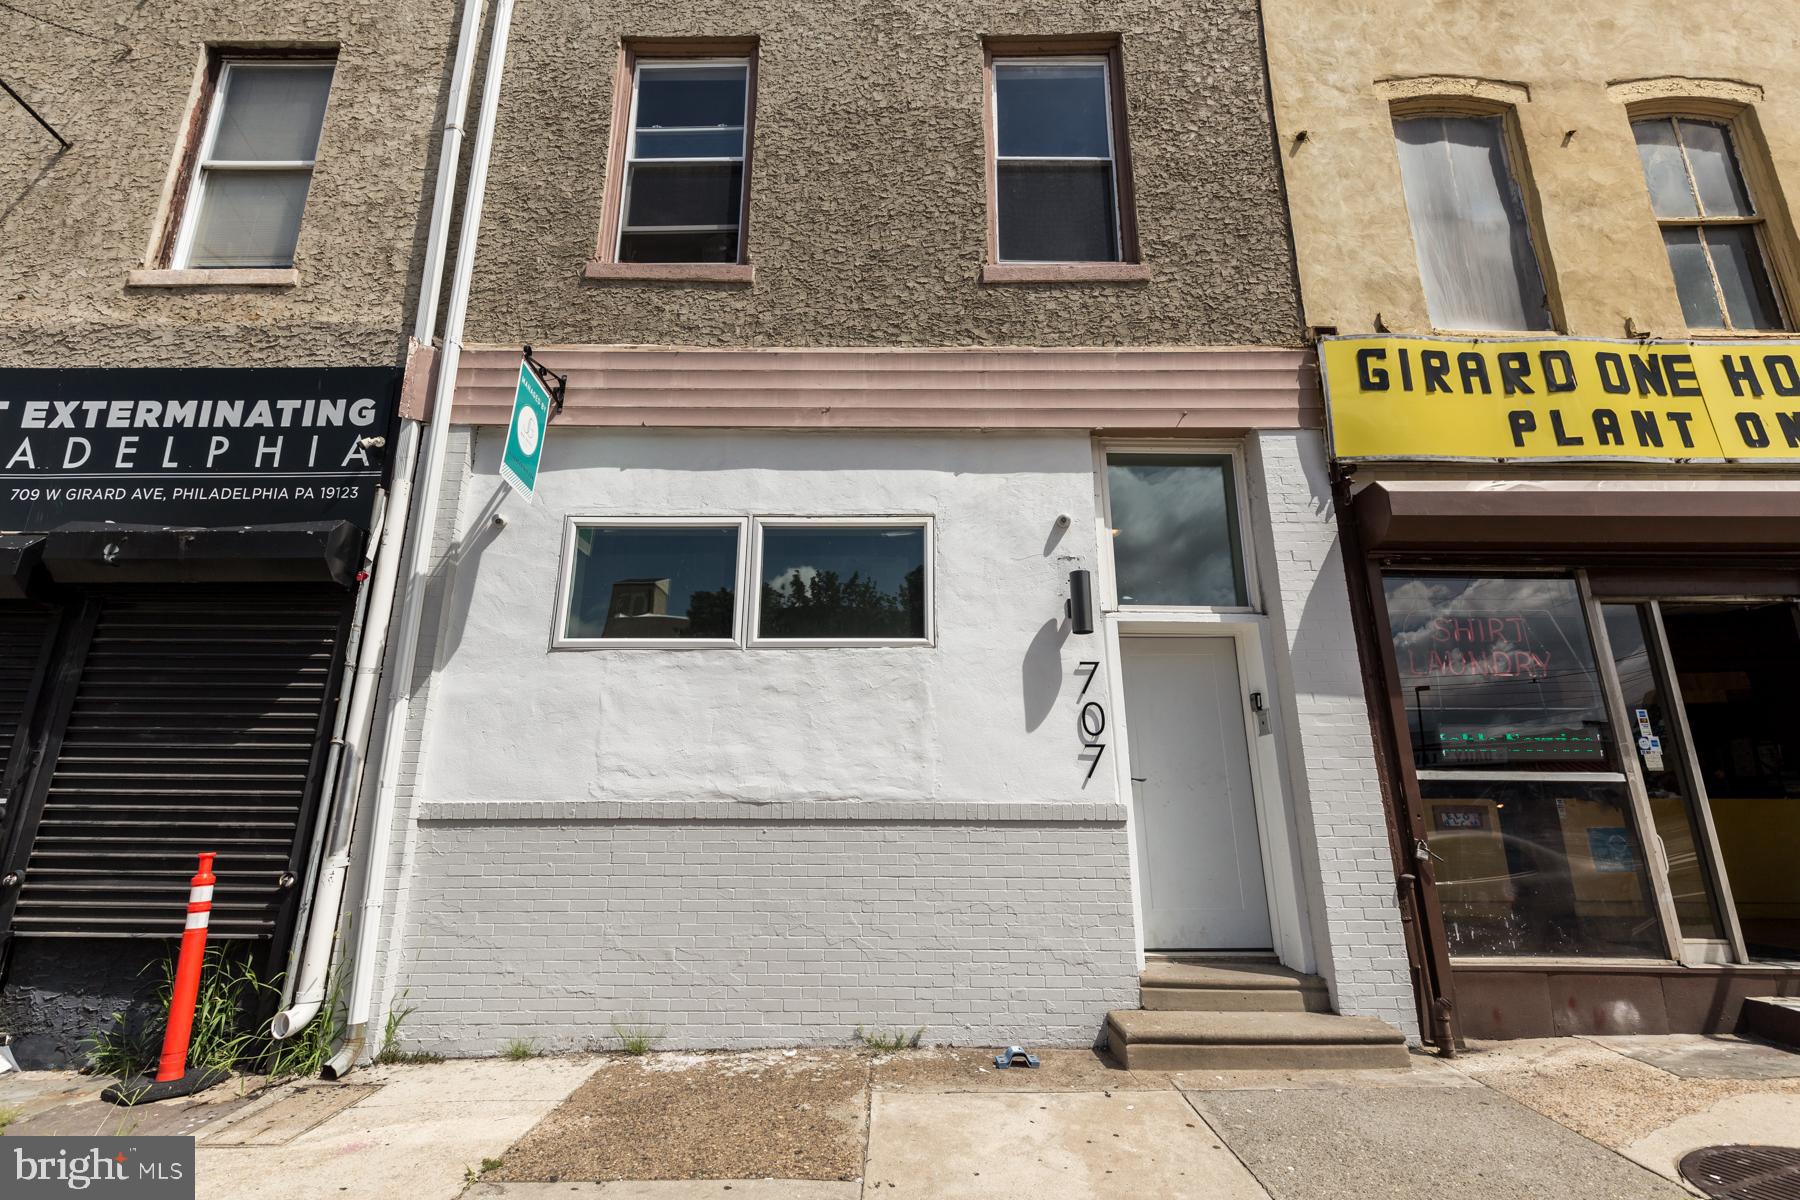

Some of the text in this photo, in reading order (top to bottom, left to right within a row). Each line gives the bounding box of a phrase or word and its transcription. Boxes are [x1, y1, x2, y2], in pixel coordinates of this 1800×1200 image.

[1356, 348, 1579, 395] GIRARD
[1595, 351, 1701, 397] ONE
[21, 398, 376, 428] EXTERMINATING
[1508, 409, 1694, 449] PLANT
[5, 433, 370, 469] ADELPHIA
[10, 486, 360, 502] 709 W GIRARD AVE, PHILADELPHIA PA 19123
[1432, 616, 1527, 645] SHIRT
[1406, 649, 1553, 679] LAUNDRY
[1079, 661, 1106, 778] 707
